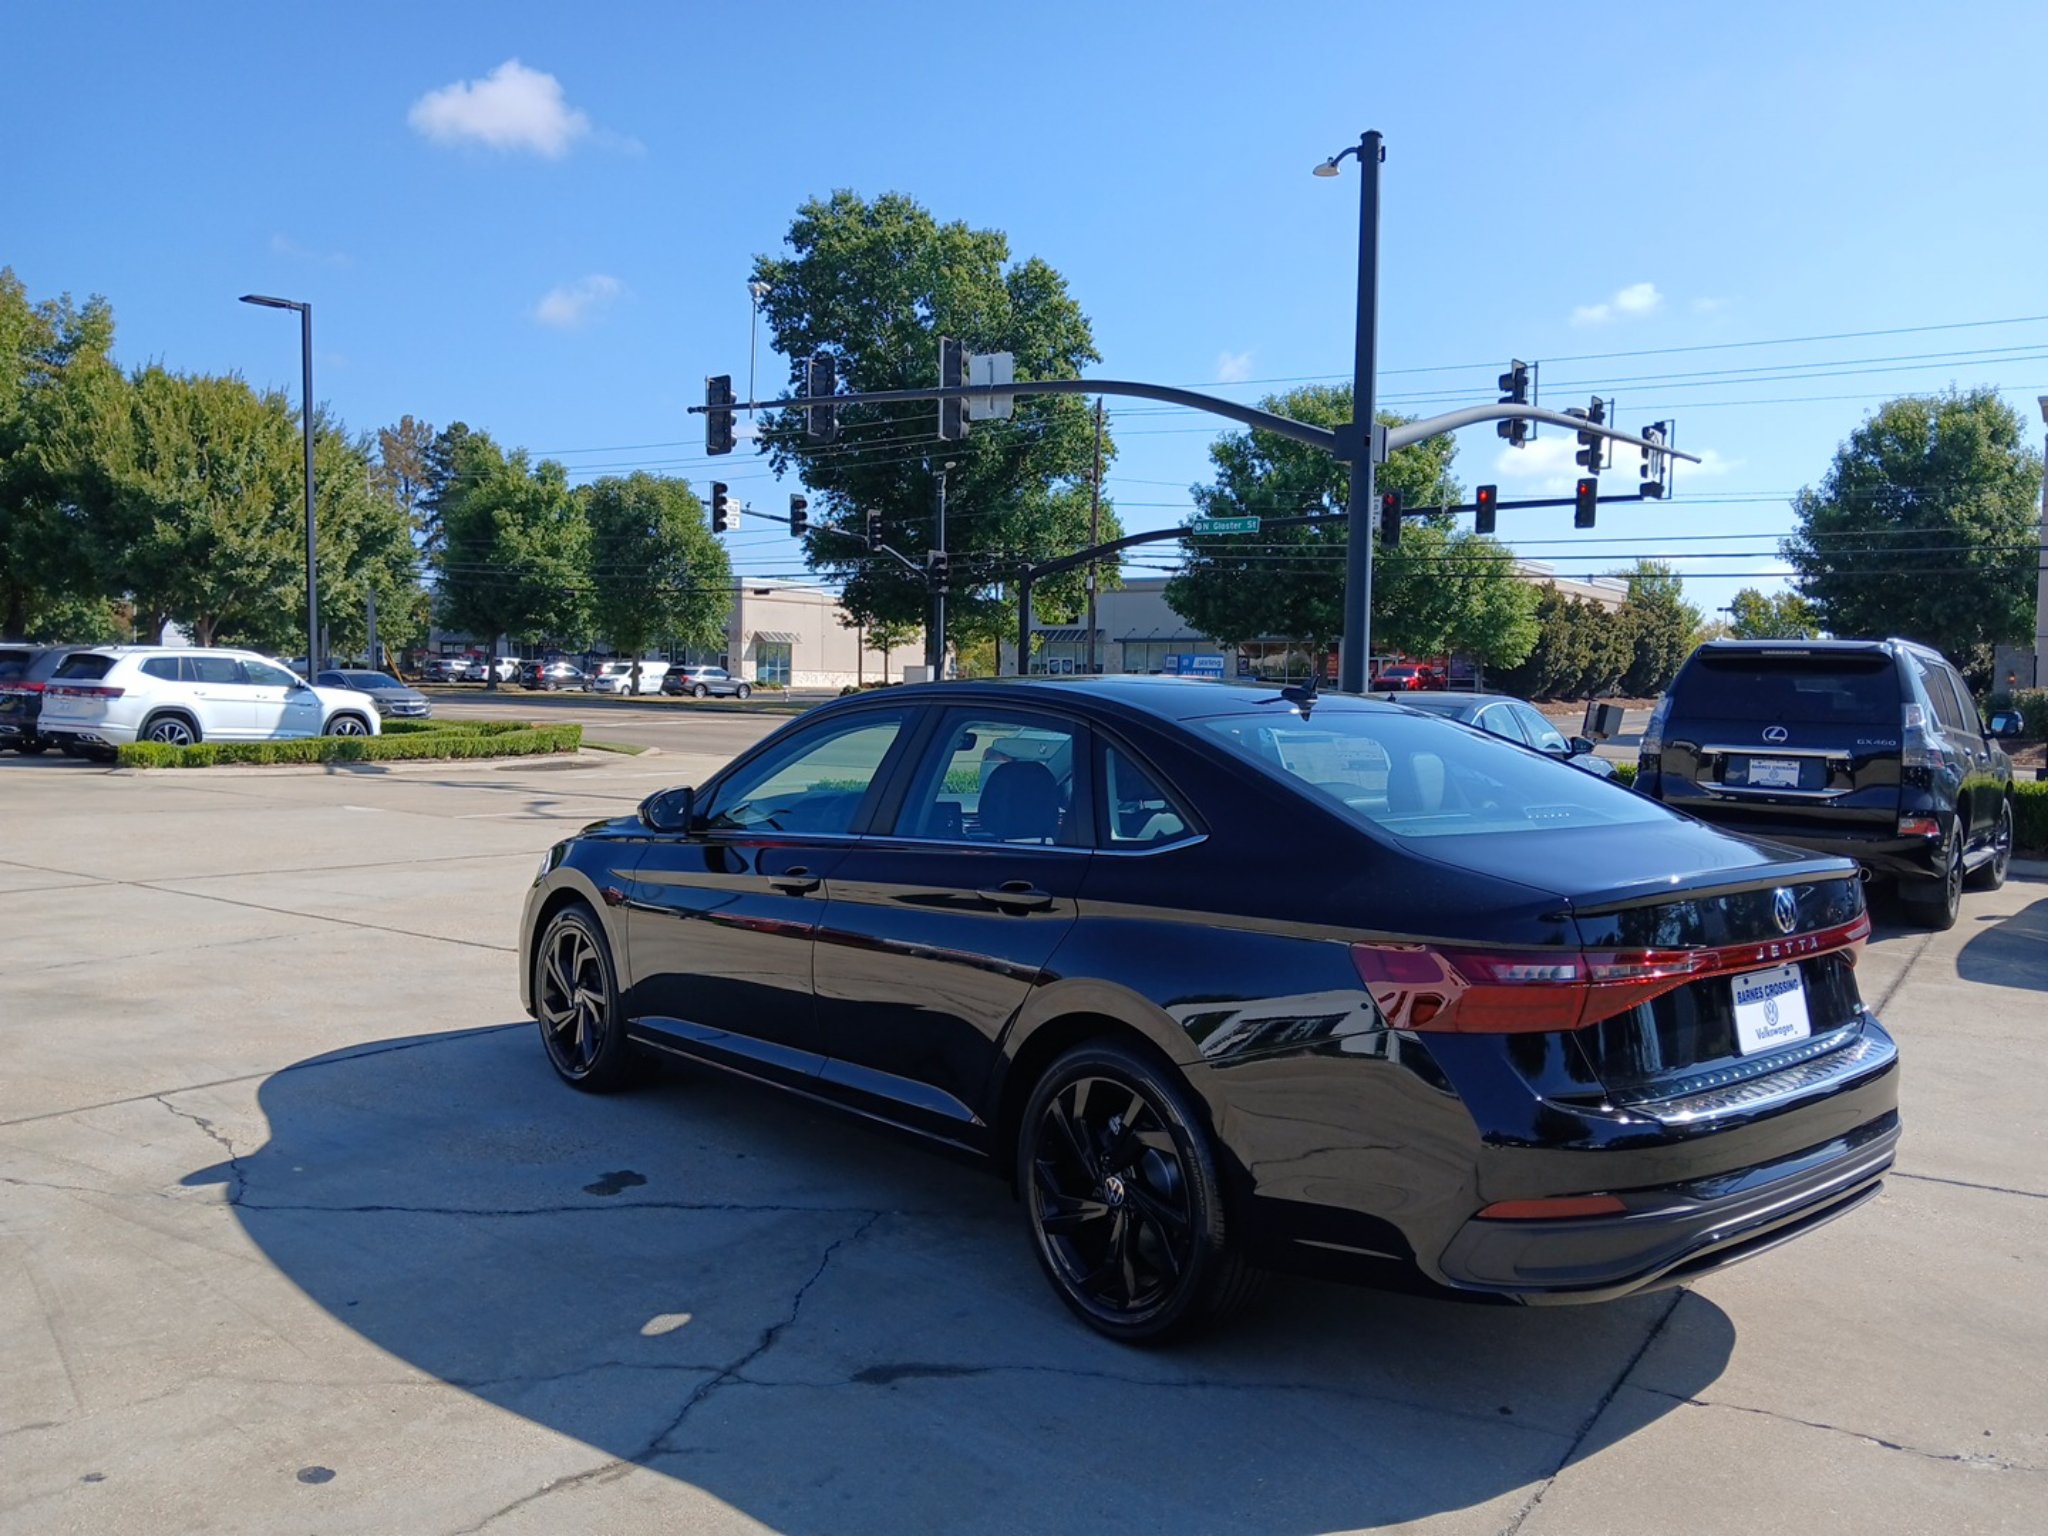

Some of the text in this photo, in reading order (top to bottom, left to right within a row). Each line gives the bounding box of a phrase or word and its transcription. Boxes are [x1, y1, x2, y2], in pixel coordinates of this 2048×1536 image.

[1203, 520, 1256, 530] N Gloster St
[1756, 938, 1819, 960] JETTA
[1737, 978, 1798, 1004] BARNES CROSSING
[1755, 1023, 1794, 1040] Volkswagen
